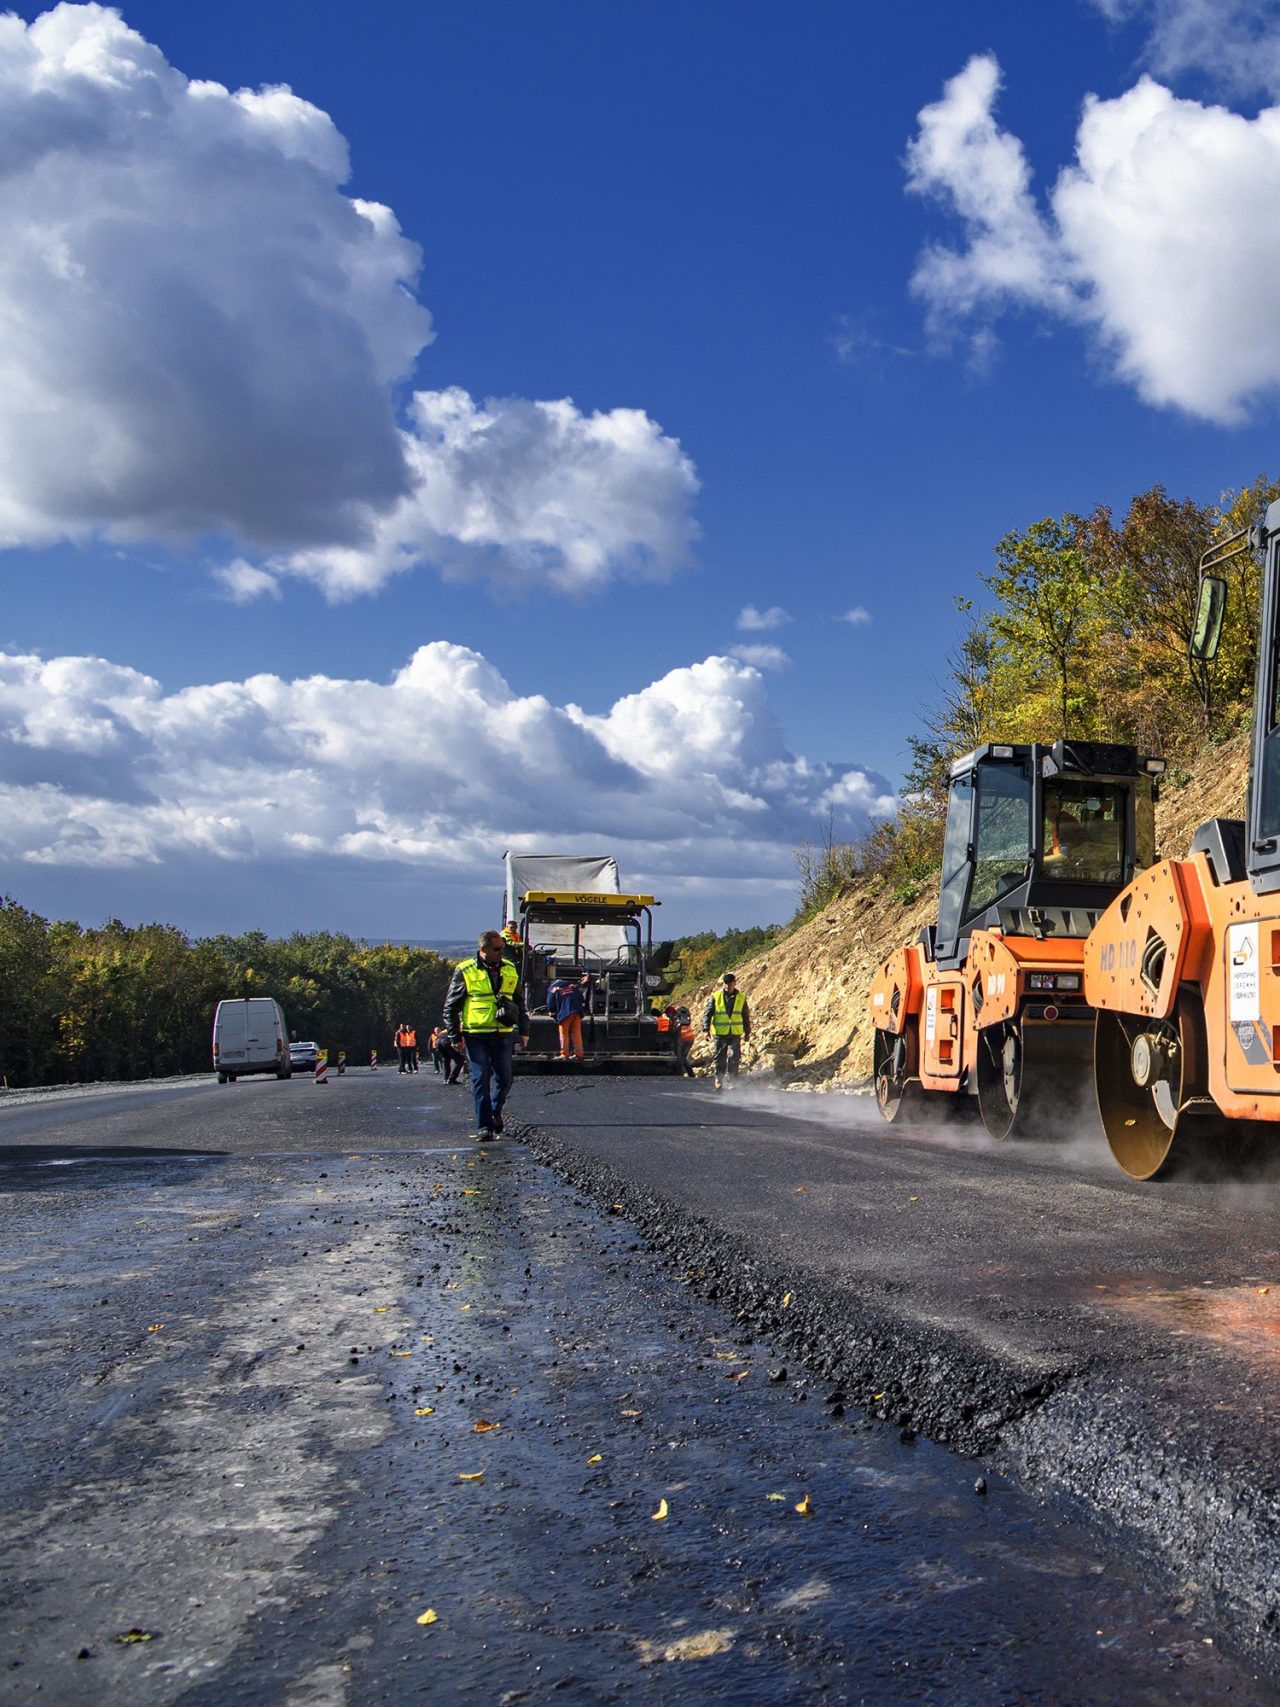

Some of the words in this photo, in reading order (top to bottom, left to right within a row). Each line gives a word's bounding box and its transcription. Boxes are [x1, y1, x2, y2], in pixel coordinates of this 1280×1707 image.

[575, 894, 608, 904] VÖGELE
[1100, 943, 1115, 972] HD
[1119, 939, 1137, 969] 110
